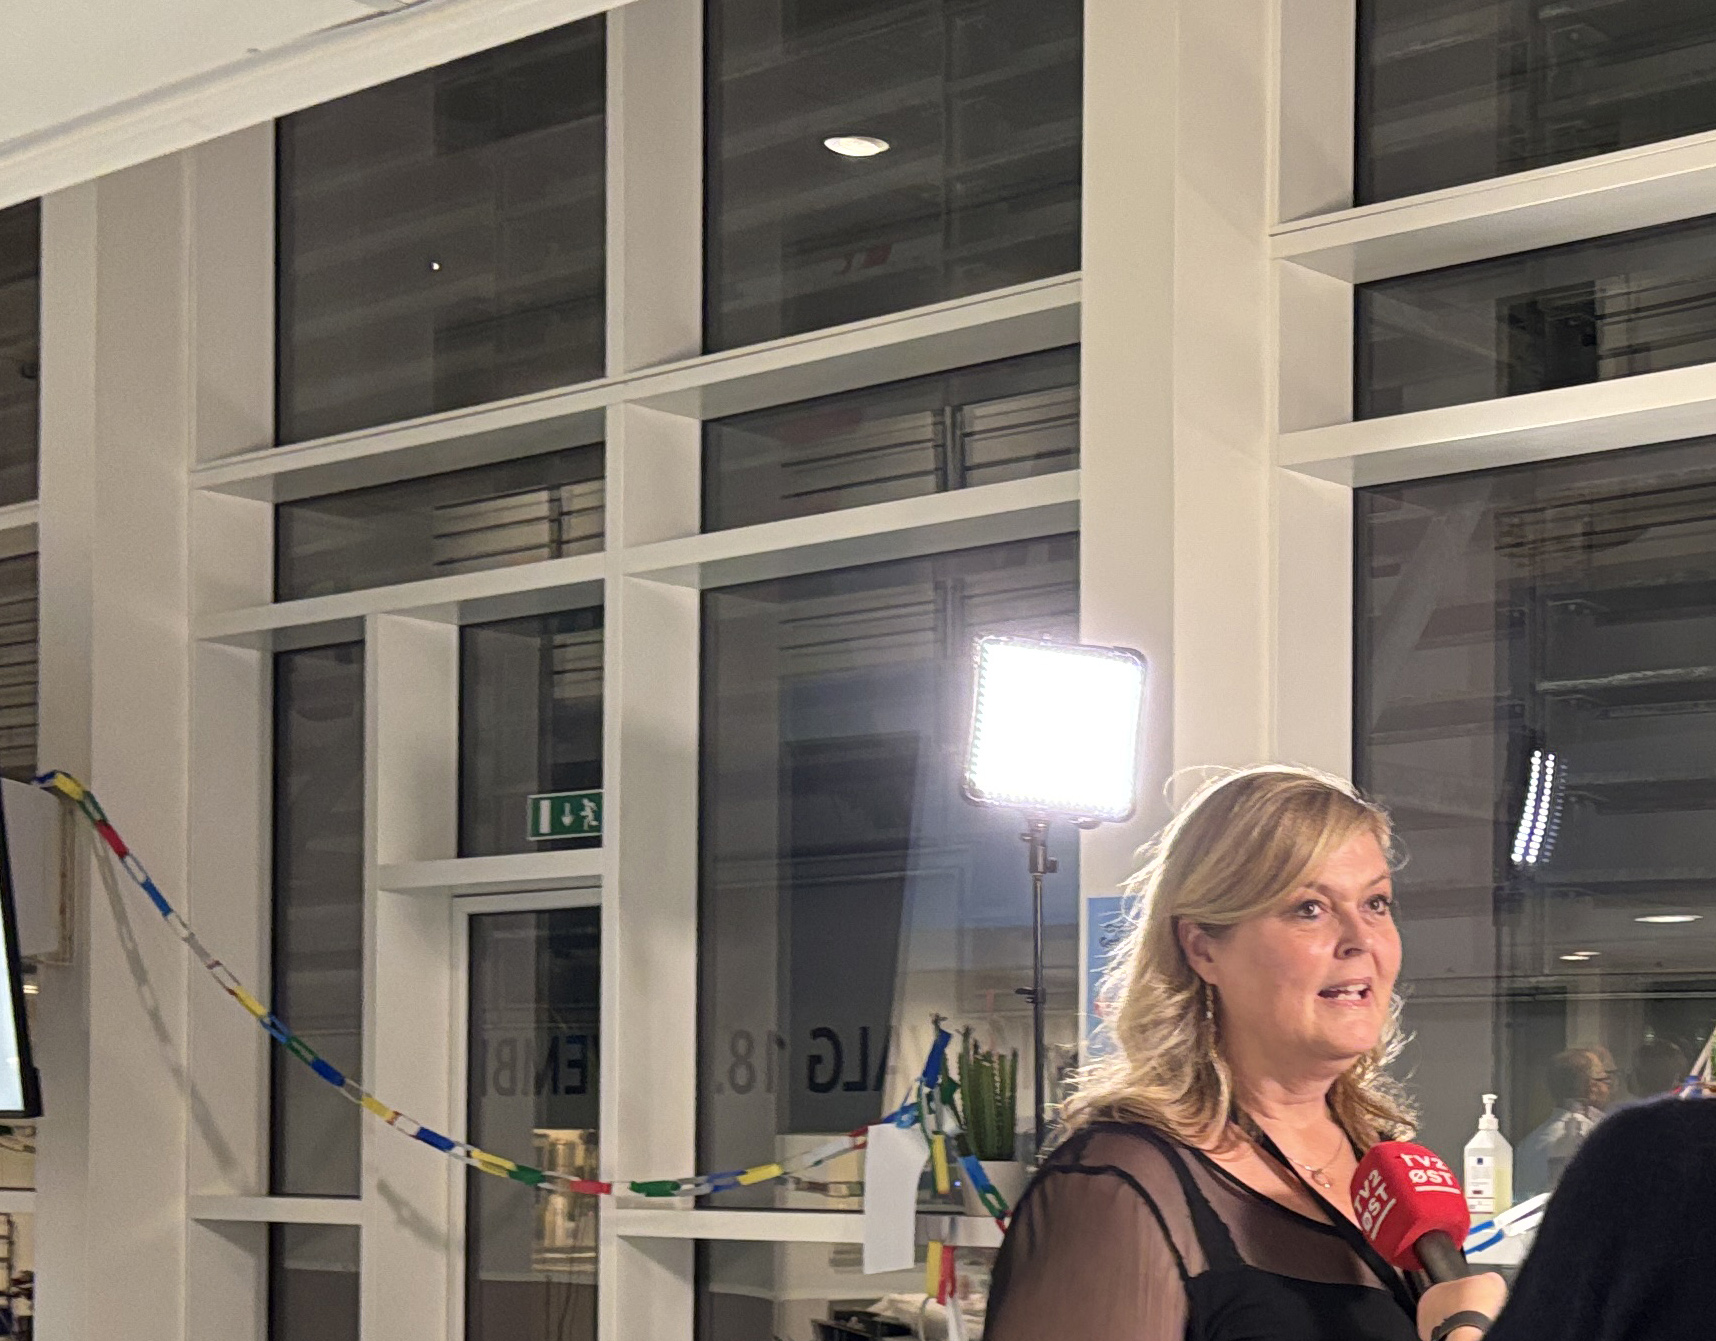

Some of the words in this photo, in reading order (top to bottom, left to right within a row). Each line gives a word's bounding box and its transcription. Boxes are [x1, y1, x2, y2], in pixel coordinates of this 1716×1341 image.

[1354, 1170, 1383, 1214] TV2
[1408, 1168, 1454, 1186] ØST
[1361, 1182, 1389, 1233] ØST
